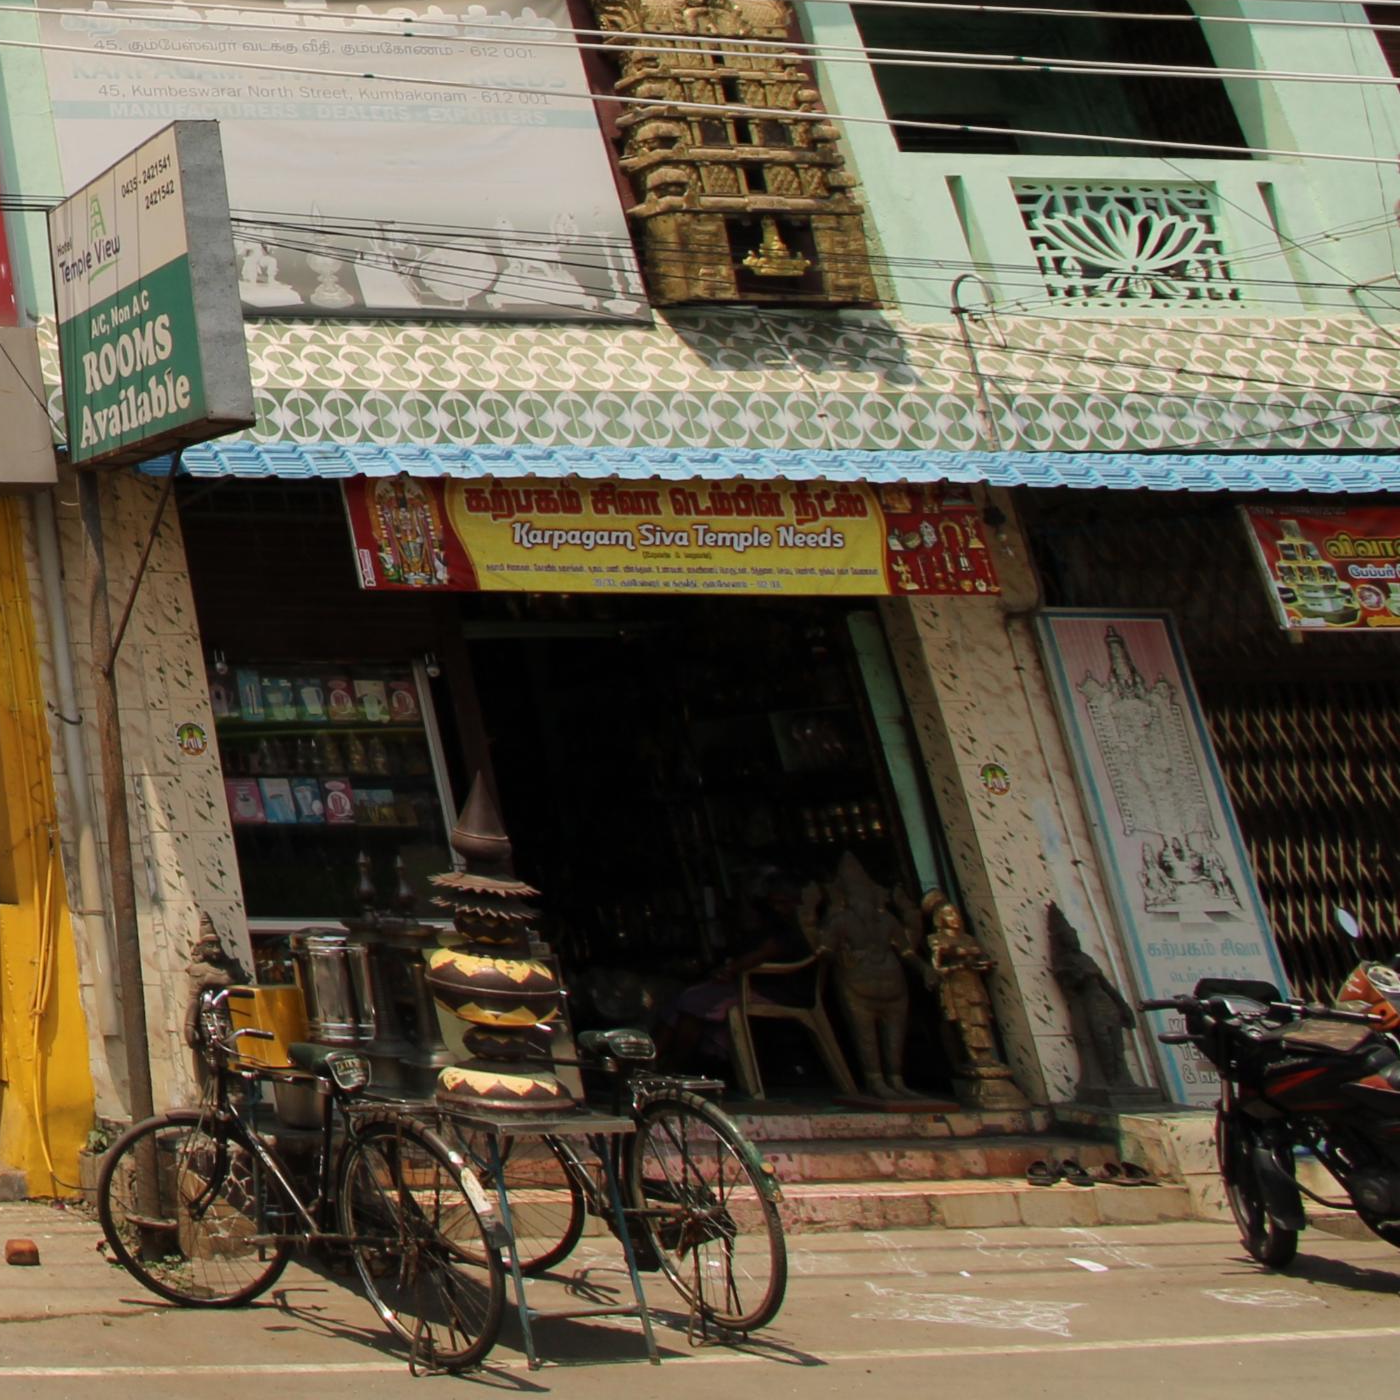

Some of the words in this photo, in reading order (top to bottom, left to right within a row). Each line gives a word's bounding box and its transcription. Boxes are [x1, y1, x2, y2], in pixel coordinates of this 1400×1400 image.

[470, 46, 499, 58] 612
[130, 84, 242, 98] Kumbeswarar
[247, 85, 295, 98] North
[359, 87, 468, 103] Kumbakonam
[481, 90, 513, 103] 612
[316, 104, 409, 120] DEALERS
[121, 174, 139, 199] 0435
[142, 154, 173, 185] 2421541
[145, 180, 176, 210] 2421542
[56, 236, 74, 257] Hotel
[58, 248, 93, 285] Temple
[92, 234, 122, 265] View
[110, 304, 131, 328] Non
[82, 313, 174, 395] ROOMS
[79, 368, 191, 450] Available
[464, 478, 584, 522] கற்பகம்
[590, 482, 663, 516] சிவா
[512, 522, 637, 550] Karpagam
[638, 523, 689, 547] Siva
[692, 524, 772, 552] Temple
[776, 525, 845, 548] Needs
[1325, 531, 1400, 560] விவா
